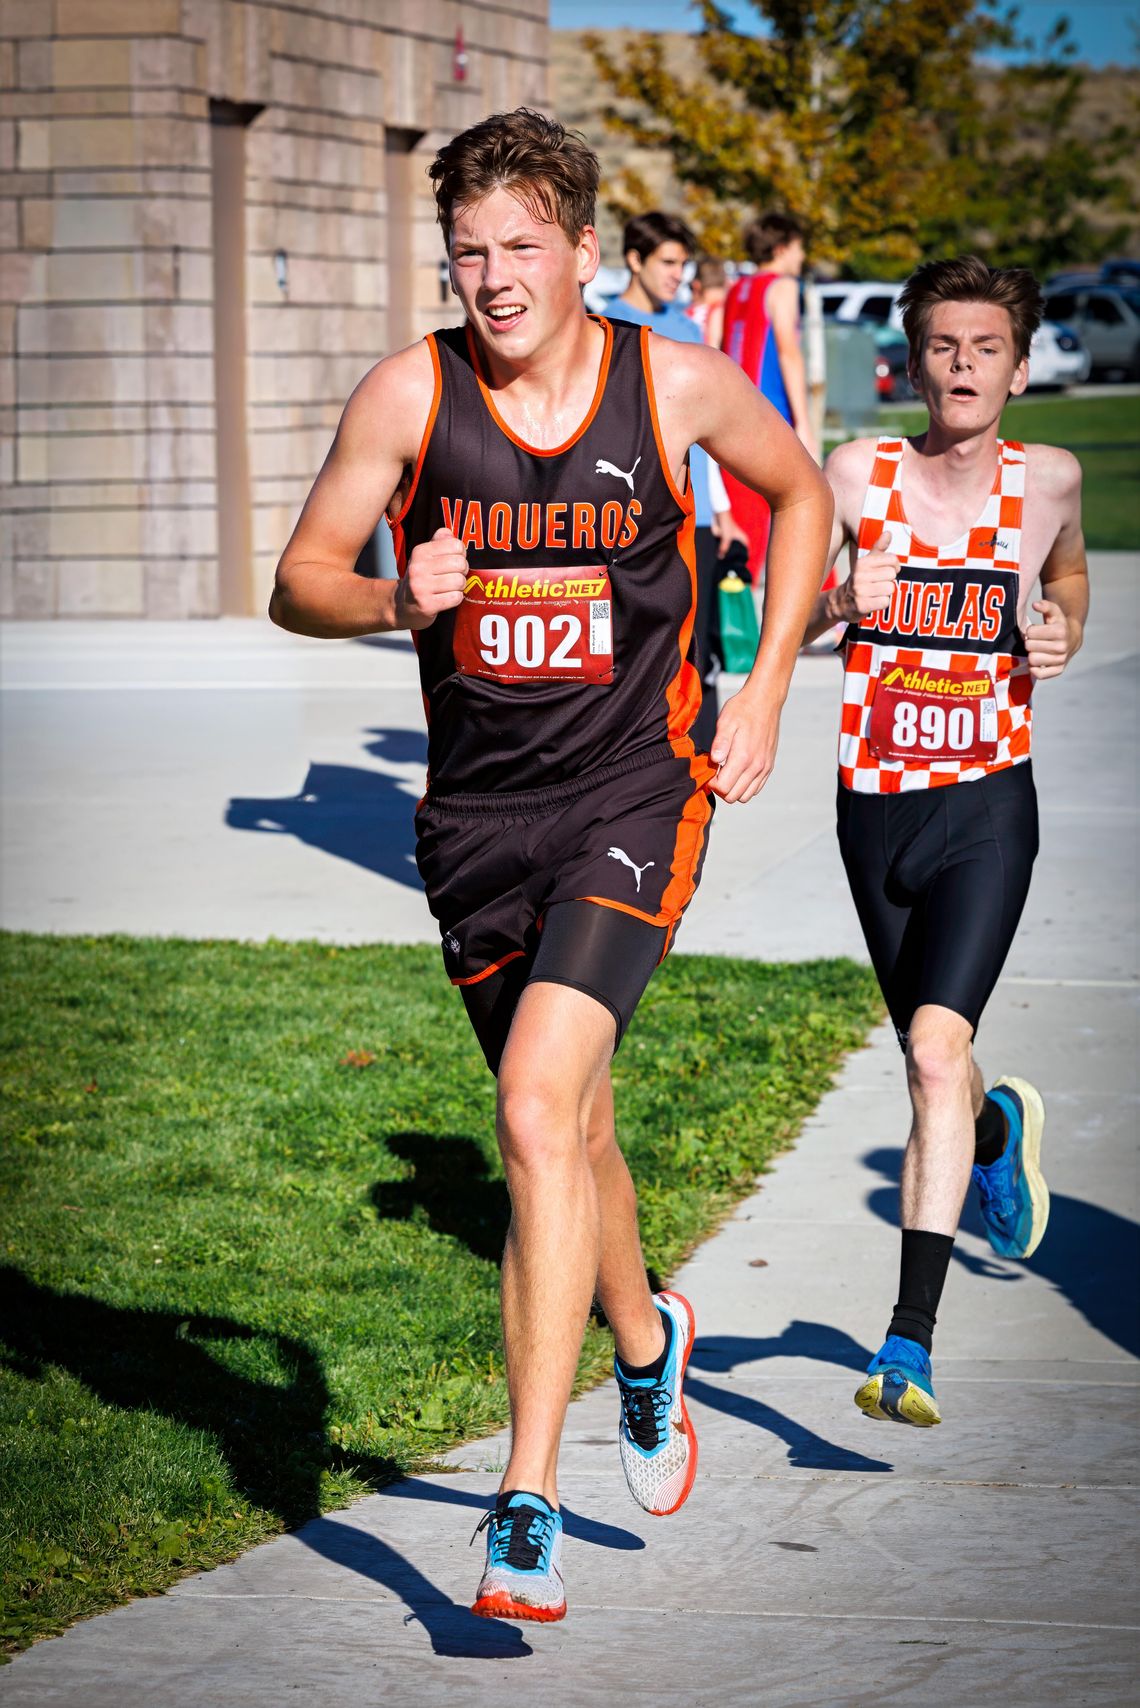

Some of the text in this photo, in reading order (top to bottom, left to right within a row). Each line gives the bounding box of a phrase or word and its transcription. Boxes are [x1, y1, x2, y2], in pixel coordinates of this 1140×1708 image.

[441, 497, 642, 551] VAQUEROS
[859, 580, 1005, 641] OUGLAS
[480, 614, 582, 668] 902
[892, 701, 973, 750] 890
